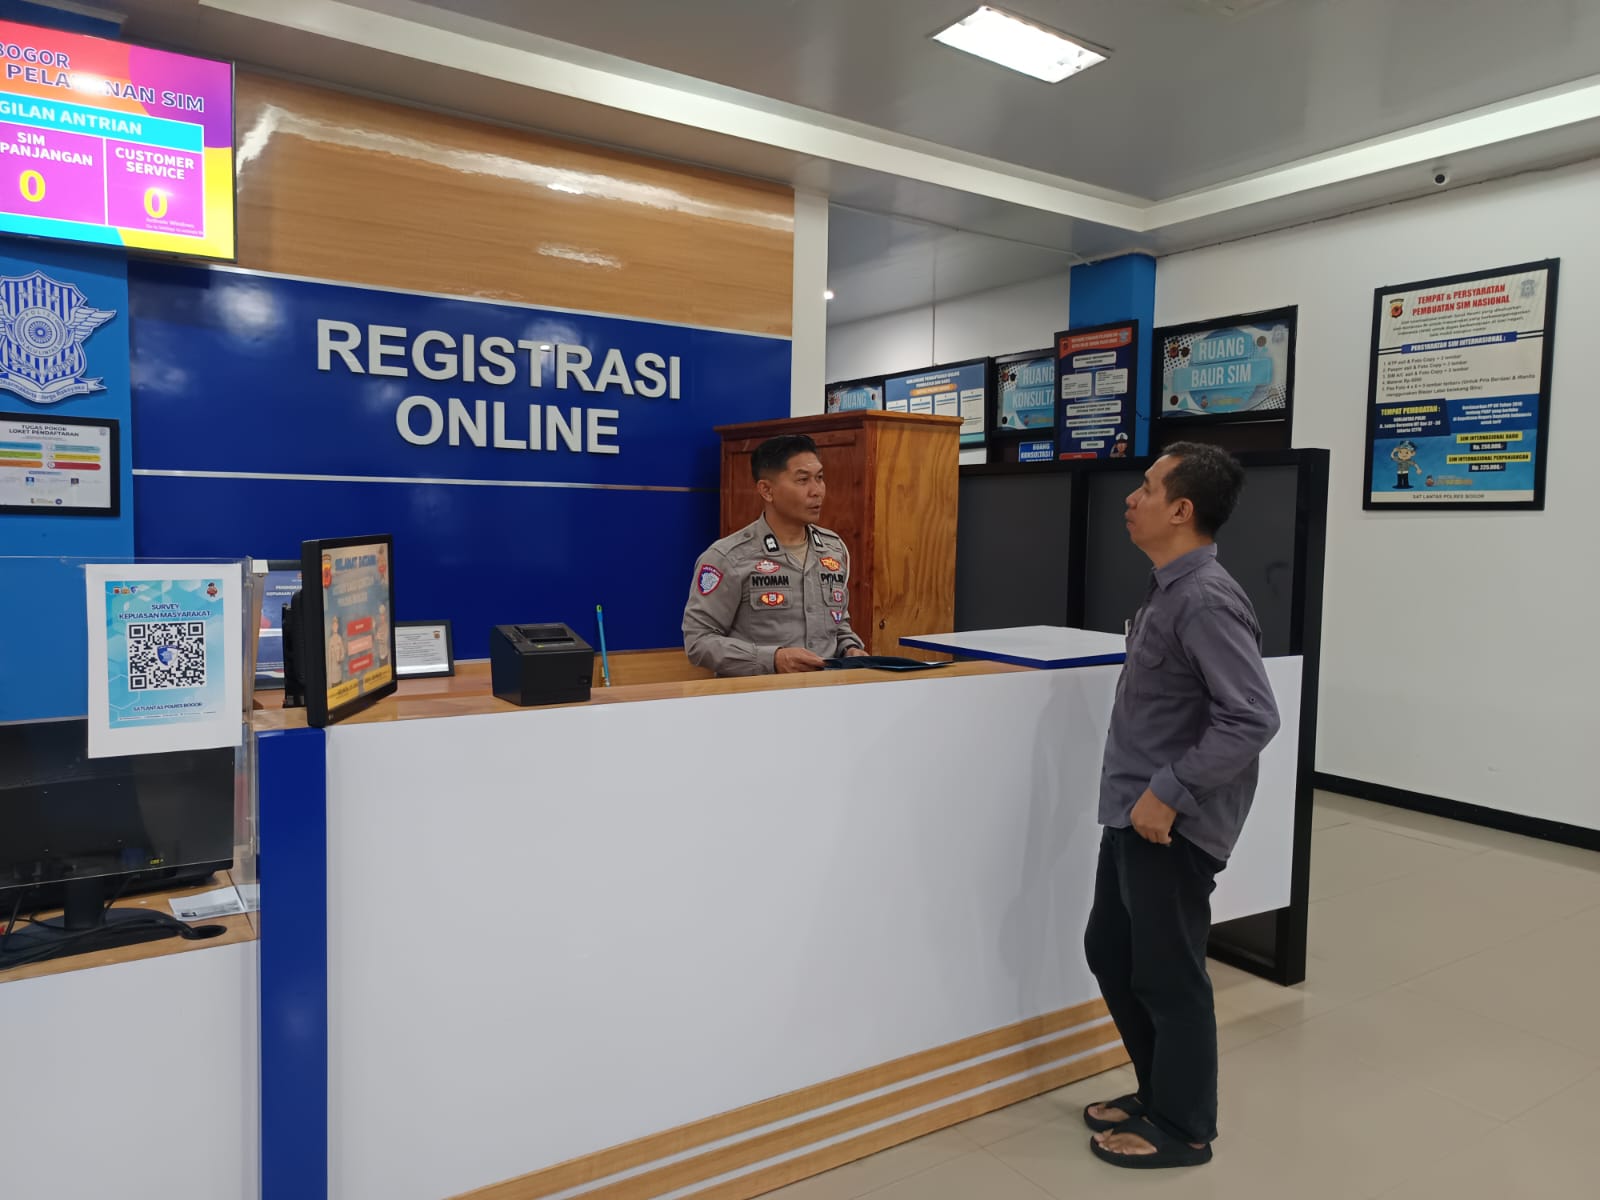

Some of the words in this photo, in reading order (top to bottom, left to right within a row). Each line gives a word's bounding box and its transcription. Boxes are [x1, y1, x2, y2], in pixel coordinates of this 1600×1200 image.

[7, 64, 155, 104] PELANAN
[163, 92, 205, 112] SIM
[0, 100, 55, 122] GILAN
[60, 110, 142, 136] ANTRIAN
[17, 131, 46, 147] SIM
[1, 142, 93, 167] PANJANGAN
[115, 147, 195, 170] CUSTOMER
[126, 161, 185, 180] SERVICE
[19, 169, 46, 203] 0
[144, 187, 168, 219] 0
[1412, 303, 1455, 316] PEMBUATAN
[1456, 300, 1471, 310] SIM
[1472, 294, 1510, 308] NASIONAL
[1418, 293, 1445, 305] TEMPAT
[1446, 293, 1452, 301] &
[1453, 284, 1506, 299] PERSYARATAN
[317, 318, 681, 400] REGISTRASI
[1199, 337, 1245, 360] RUANG
[1023, 366, 1054, 385] RUANG
[1192, 366, 1224, 387] BAUR
[1227, 363, 1252, 384] SIM
[842, 391, 867, 409] RUANG
[396, 395, 620, 454] ONLINE
[751, 575, 789, 587] NYOMAN
[119, 612, 159, 620] KEPUASAN
[160, 610, 210, 618] MASYARAKAT
